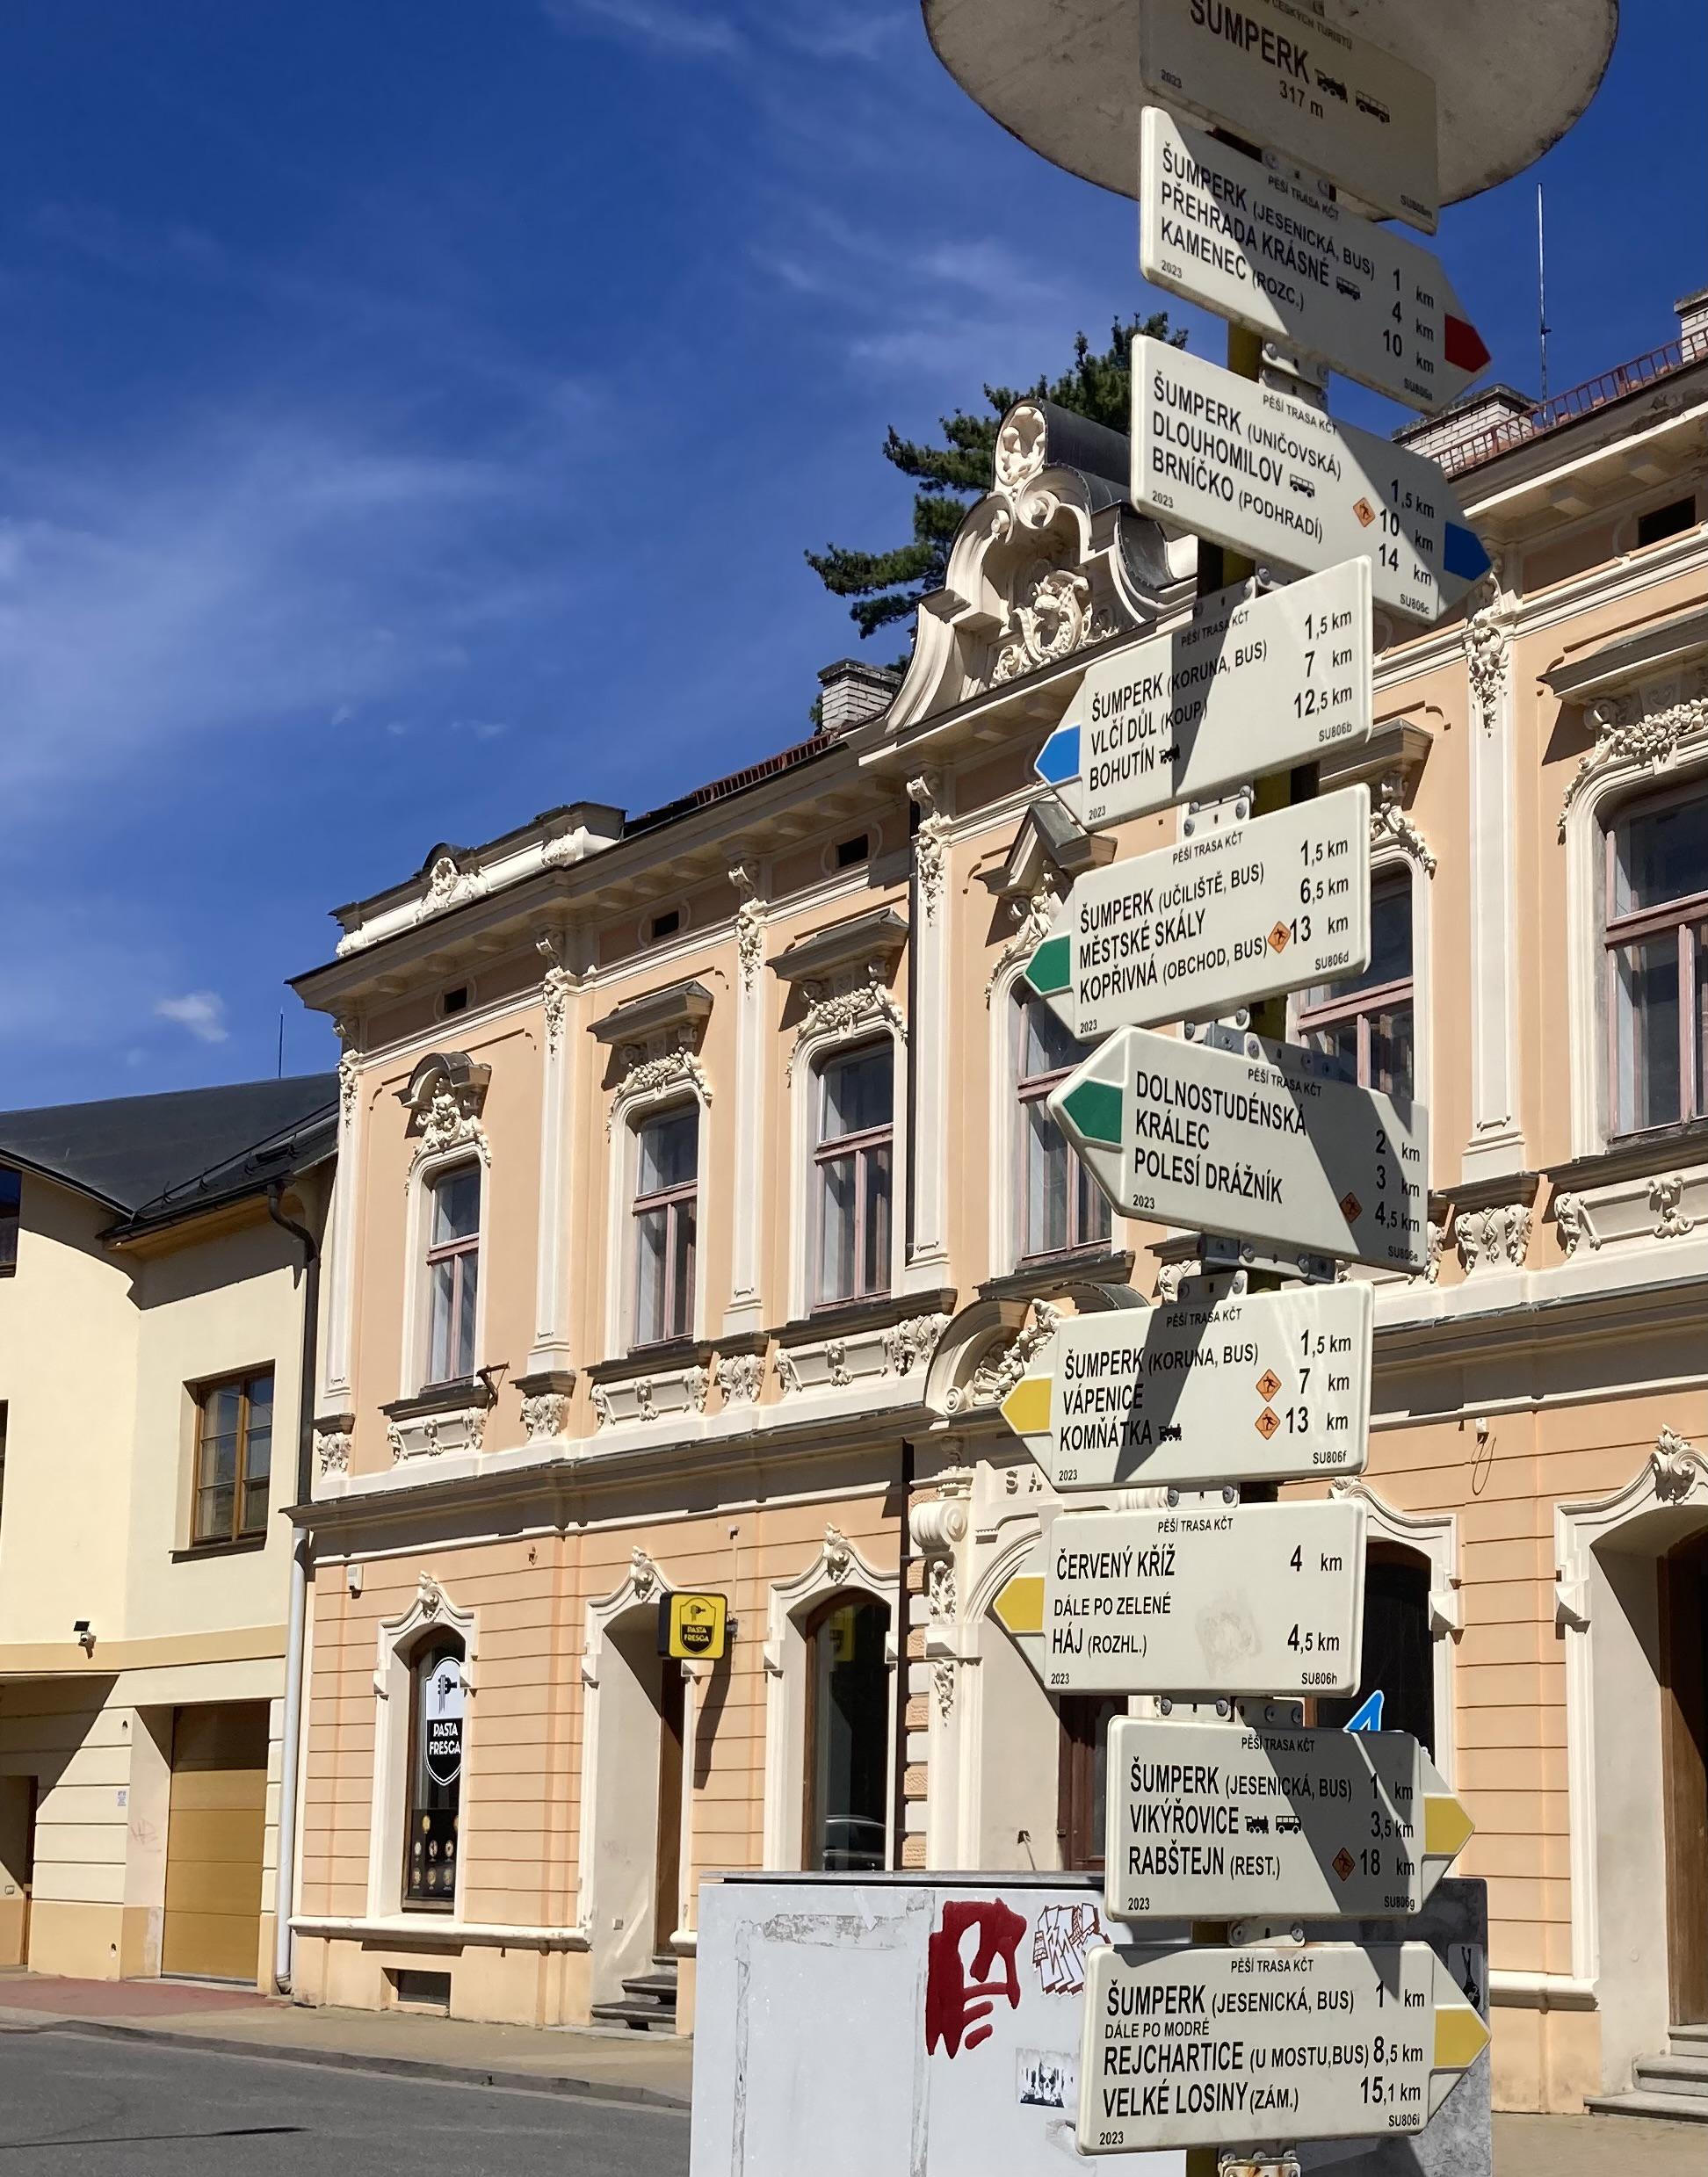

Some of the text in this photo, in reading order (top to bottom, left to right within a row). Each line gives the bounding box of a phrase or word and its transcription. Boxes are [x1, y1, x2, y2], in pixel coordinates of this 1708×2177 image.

[1280, 80, 1323, 119] 317 m
[1162, 141, 1434, 307] ŠUMPERK (JESENICKÁ, BUS) 1 km
[1160, 259, 1182, 278] 2023
[1162, 181, 1434, 341] PŘEHRADA KRÁSNÉ 4 km
[1162, 216, 1434, 373] KAMENEC (ROZC.) 10 km
[1154, 369, 1434, 518] ŠUMPERK (UNIČOVSKÁ) 1,5 km
[1153, 490, 1173, 509] 2023
[1154, 410, 1433, 552] DLOUHOMILOV 10 km
[1153, 446, 1431, 587] BRNÍČKO (PODHRADÍ) 14 km
[1092, 611, 1351, 722] ŠUMPERK (KORUNA, BUS) 1,5 km
[1091, 719, 1123, 756] VLČÍ
[1127, 708, 1156, 745] DŮL
[1305, 651, 1315, 677] 7
[1333, 648, 1352, 668] km
[1089, 687, 1352, 792] BOHUTÍN 12,5 km
[1319, 721, 1352, 741] SU806b
[1089, 806, 1105, 821] 2023
[1173, 831, 1243, 864] PĚŠÍ TRASA KČT
[1081, 839, 1348, 934] ŠUMPERK (UČILIŠTĚ, BUS) 1,5 km
[1080, 878, 1348, 969] MĚSTSKÉ SKÁLY 6,5 km
[1080, 915, 1348, 1003] KOPŘIVNÁ (OBCHOD, BUS) 13 km
[1315, 951, 1349, 970] SU806d
[1081, 1019, 1097, 1033] 2023
[1248, 1067, 1321, 1096] PĚŠÍ TRASA KČT
[1137, 1071, 1420, 1161] DOLNOSTUDÉNSKÁ 2 km
[1136, 1109, 1419, 1197] KRÁLEC 3 km
[1133, 1194, 1154, 1209] 2023
[1135, 1147, 1419, 1232] POLESÍ DRÁŽNÍK 4,5 km
[1065, 1329, 1351, 1379] ŠUMPERK (KORUNA, BUS) 1,5 km
[1063, 1369, 1349, 1415] VÁPENICE 7 km
[1060, 1407, 1348, 1451] KOMŇÁTKA 13 km
[1059, 1470, 1077, 1481] 2023
[1313, 1451, 1347, 1465] SU806f
[1158, 1515, 1233, 1533] PĚŠÍ TRASA KČT
[1057, 1544, 1342, 1580] ČERVENÝ KŘÍŽ 4 km
[1054, 1592, 1171, 1616] DÁLE PO ZELENÉ
[1053, 1622, 1339, 1658] HÁJ (ROZHL.) 4,5 km
[1051, 1673, 1069, 1684] 2023
[1301, 1673, 1337, 1685] SU806h
[429, 1740, 460, 1754] FRESCA
[433, 1723, 458, 1737] PASTA
[1241, 1734, 1314, 1752] PĚŠÍ TRASA KČT
[1131, 1756, 1413, 1802] ŠUMPERK (JESENICKÁ, BUS) 1 km
[1130, 1797, 1414, 1840] VIKÝŘOVICE 3,5 km
[1129, 1839, 1415, 1880] RABŠTEJN (REST.) 18 km
[1128, 1898, 1150, 1910] 2023
[1231, 1957, 1314, 1973] PĚŠÍ TRASA KČT
[1107, 1979, 1424, 2018] ŠUMPERK (JESENICKÁ, BUS) 1 km
[1105, 2017, 1209, 2039] DÁLE PO MODRÉ
[1104, 2042, 1243, 2075] REJCHARTICE
[1250, 2049, 1265, 2073] (U
[1373, 2036, 1397, 2066] 8,5
[1402, 2044, 1422, 2062] km
[1104, 2077, 1420, 2117] VELKÉ LOSINY (ZÁM.) 15,1 km
[1100, 2131, 1124, 2145] 2023
[1389, 2114, 1420, 2127] SU806i
